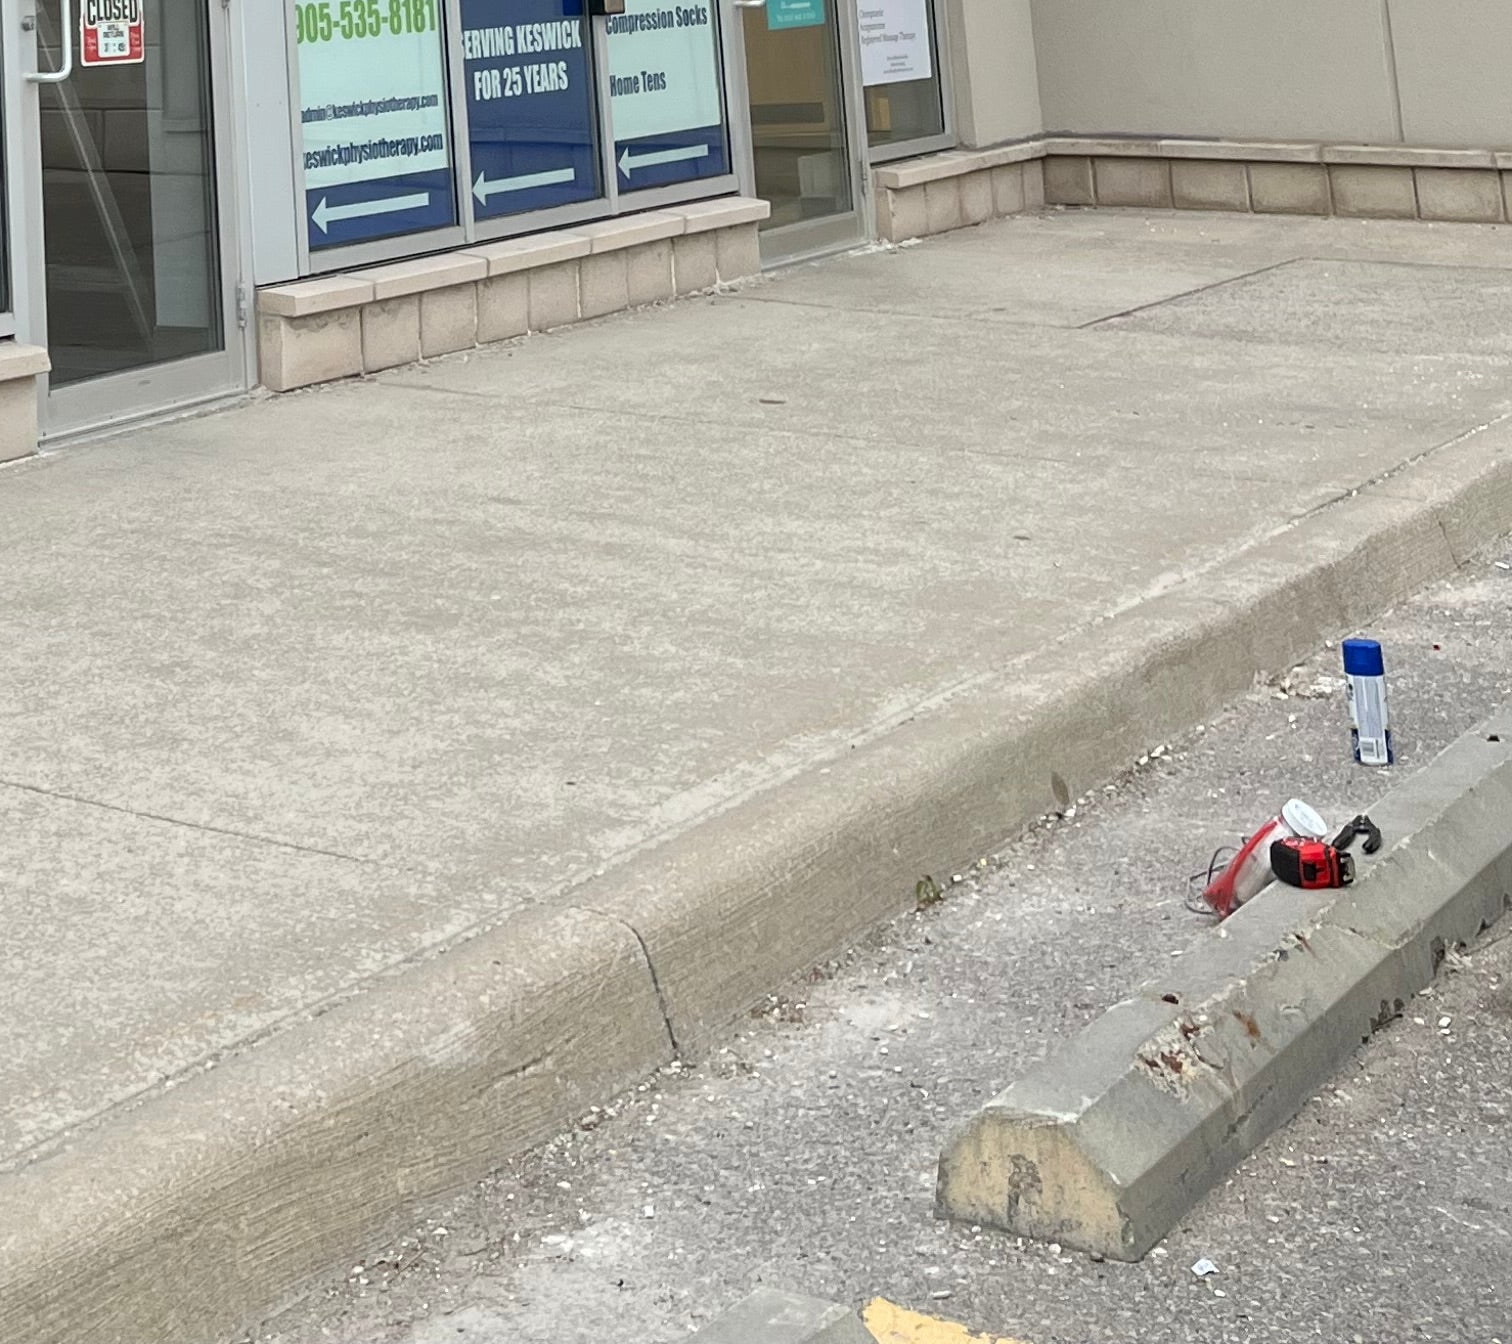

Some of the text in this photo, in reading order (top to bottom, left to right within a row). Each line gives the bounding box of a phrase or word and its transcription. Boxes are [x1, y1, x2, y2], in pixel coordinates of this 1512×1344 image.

[605, 4, 708, 35] Compression Socks
[462, 20, 582, 60] ERVING KESWICK
[474, 61, 569, 101] FOR 25 YEARS
[610, 71, 667, 97] Home Tens
[303, 133, 444, 171] eswickphysiotherapy.com
